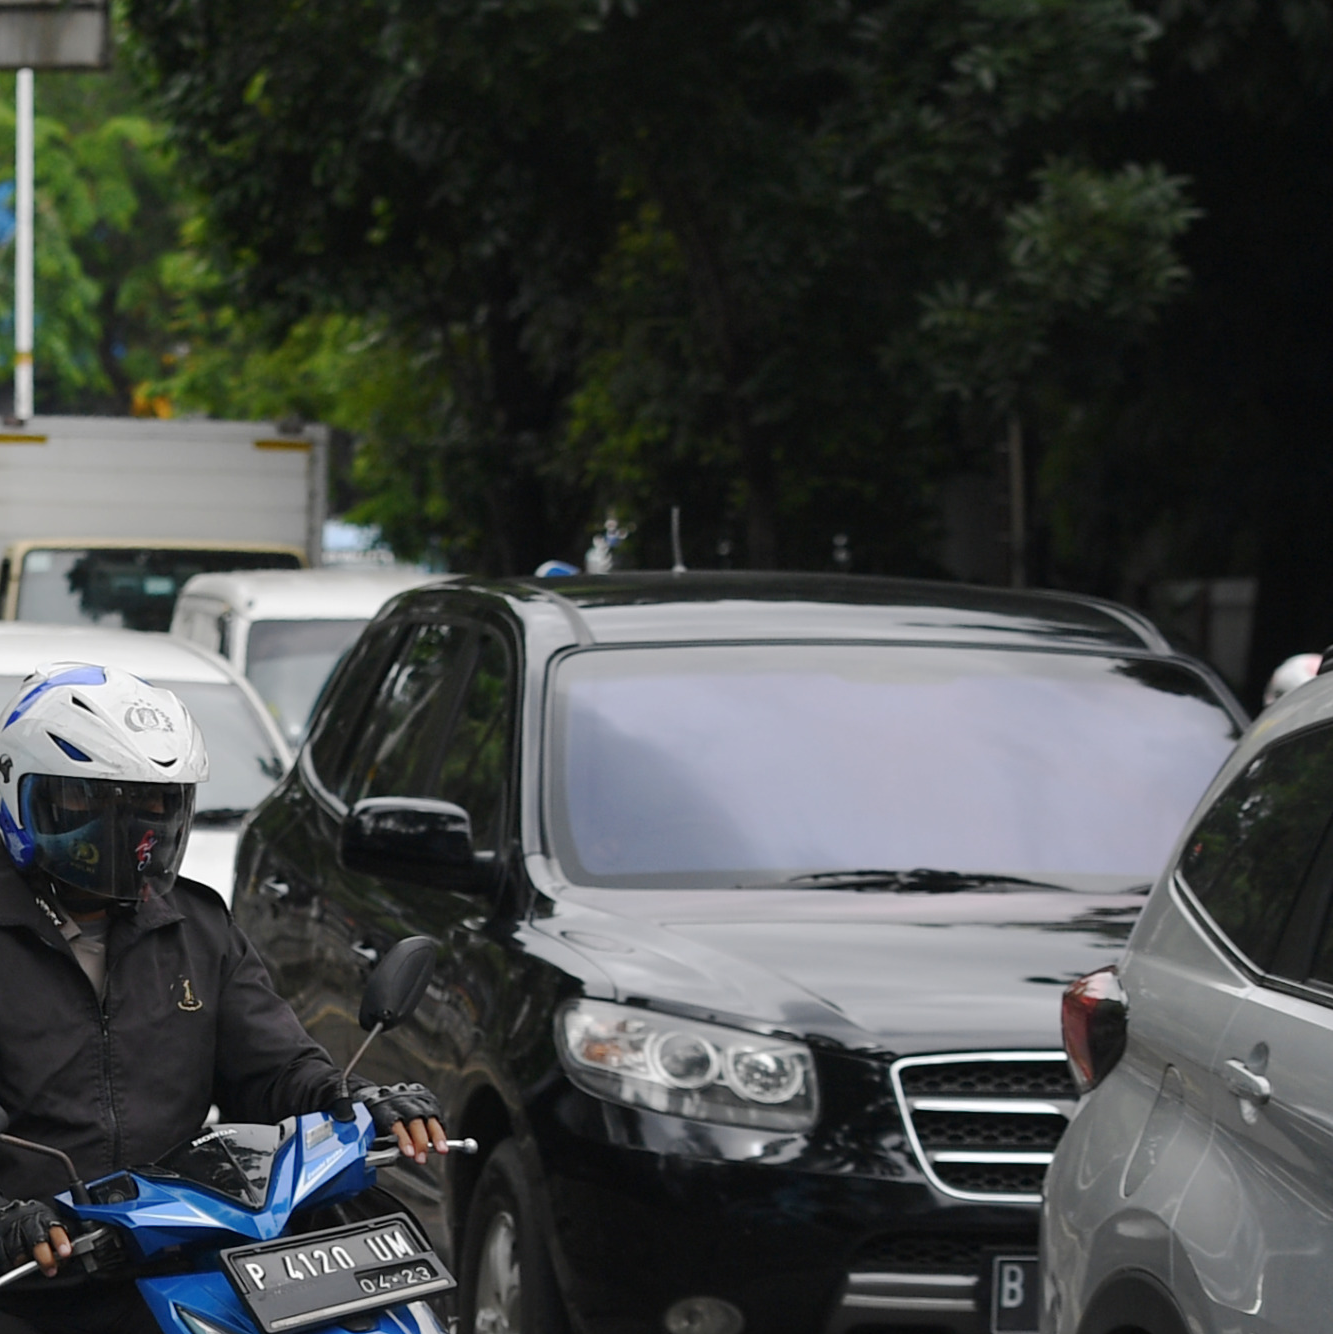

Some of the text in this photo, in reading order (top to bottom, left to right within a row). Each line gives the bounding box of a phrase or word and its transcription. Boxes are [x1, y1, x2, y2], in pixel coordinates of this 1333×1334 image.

[190, 1128, 238, 1148] HONDA
[245, 1263, 266, 1290] P
[282, 1245, 356, 1280] 4120
[365, 1230, 415, 1262] UM
[1002, 1264, 1024, 1308] B
